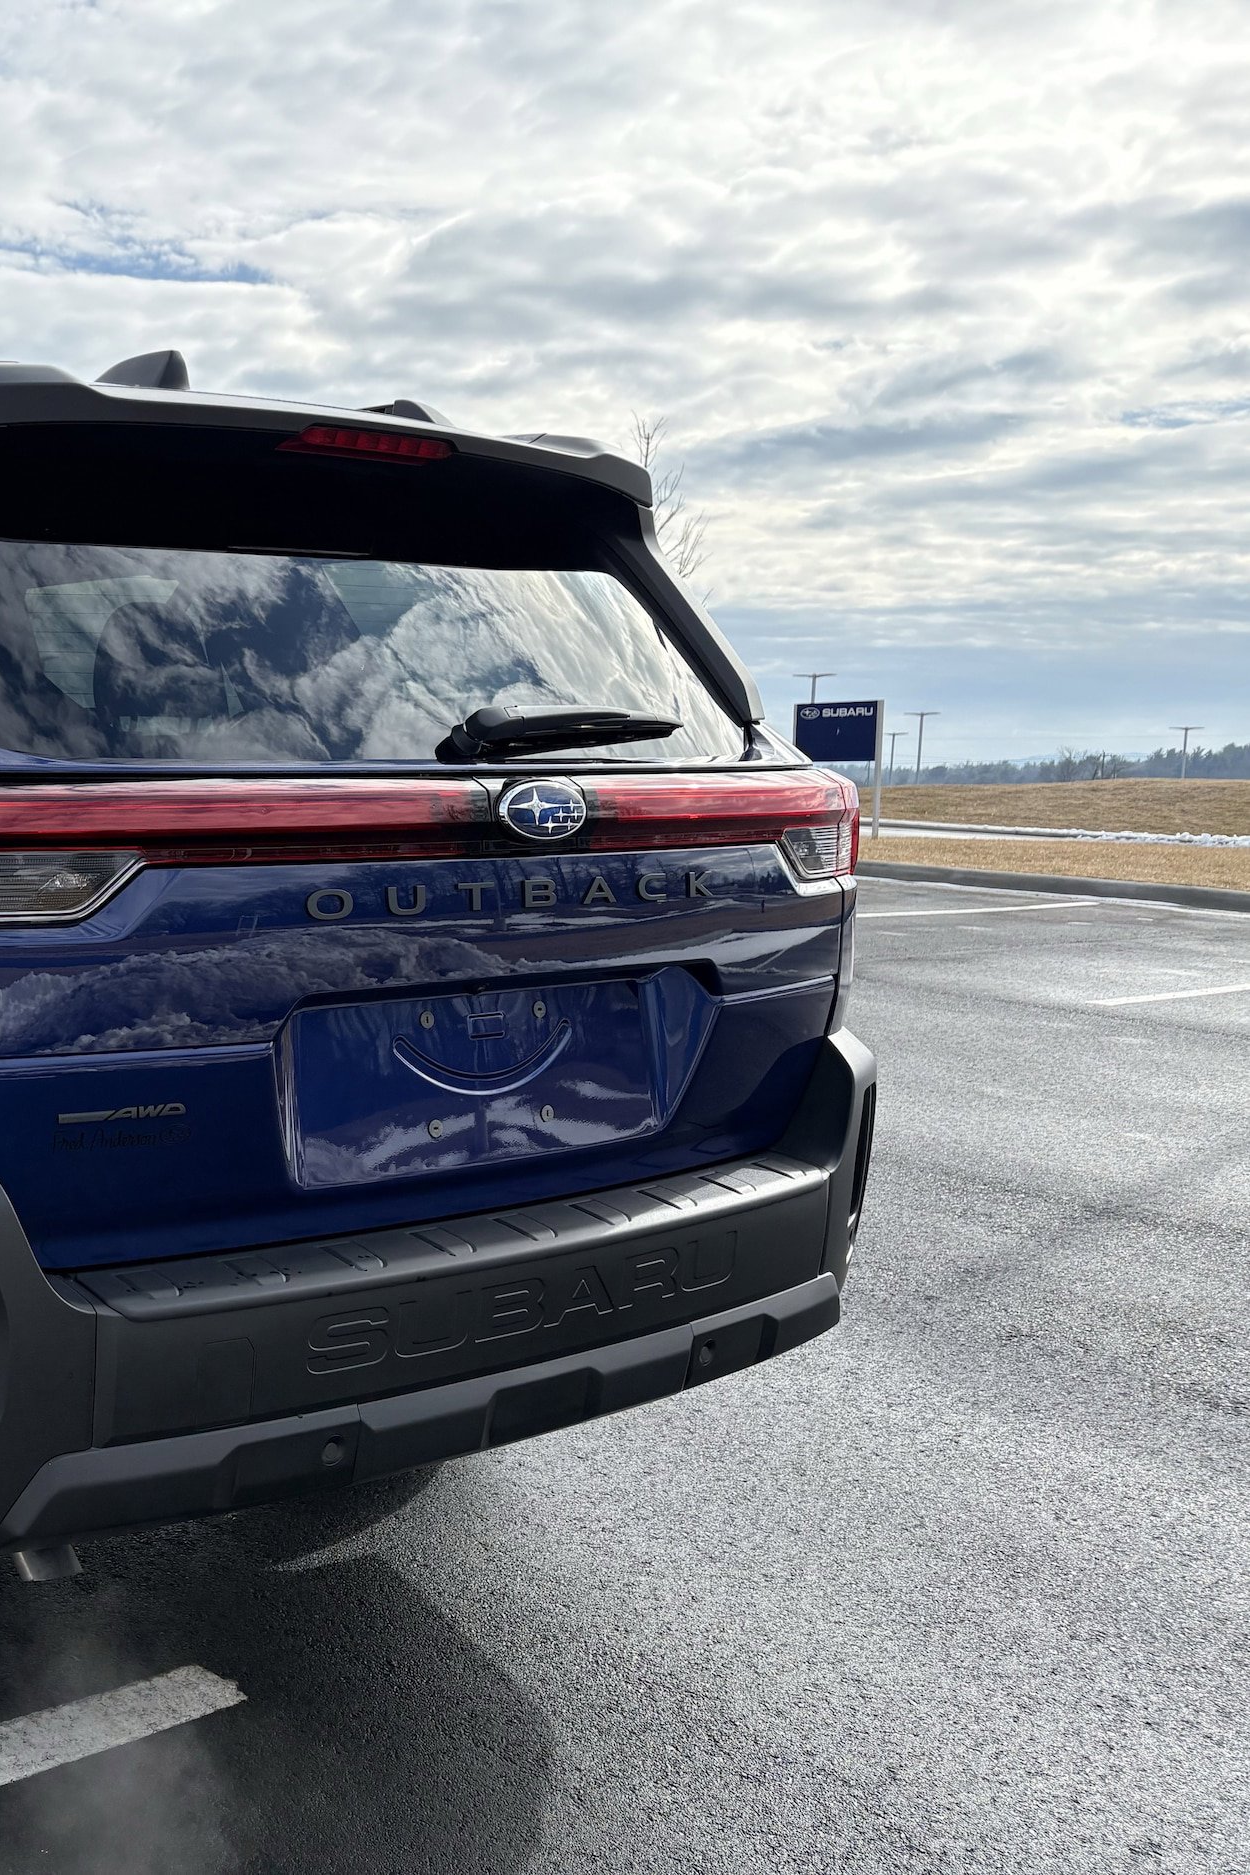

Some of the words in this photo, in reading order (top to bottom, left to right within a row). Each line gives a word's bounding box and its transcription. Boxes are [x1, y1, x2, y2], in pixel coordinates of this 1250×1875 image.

[822, 706, 874, 718] SUBARU
[305, 870, 714, 921] OUTBACK
[106, 1101, 188, 1121] AWD
[306, 1229, 738, 1376] SUBARU
